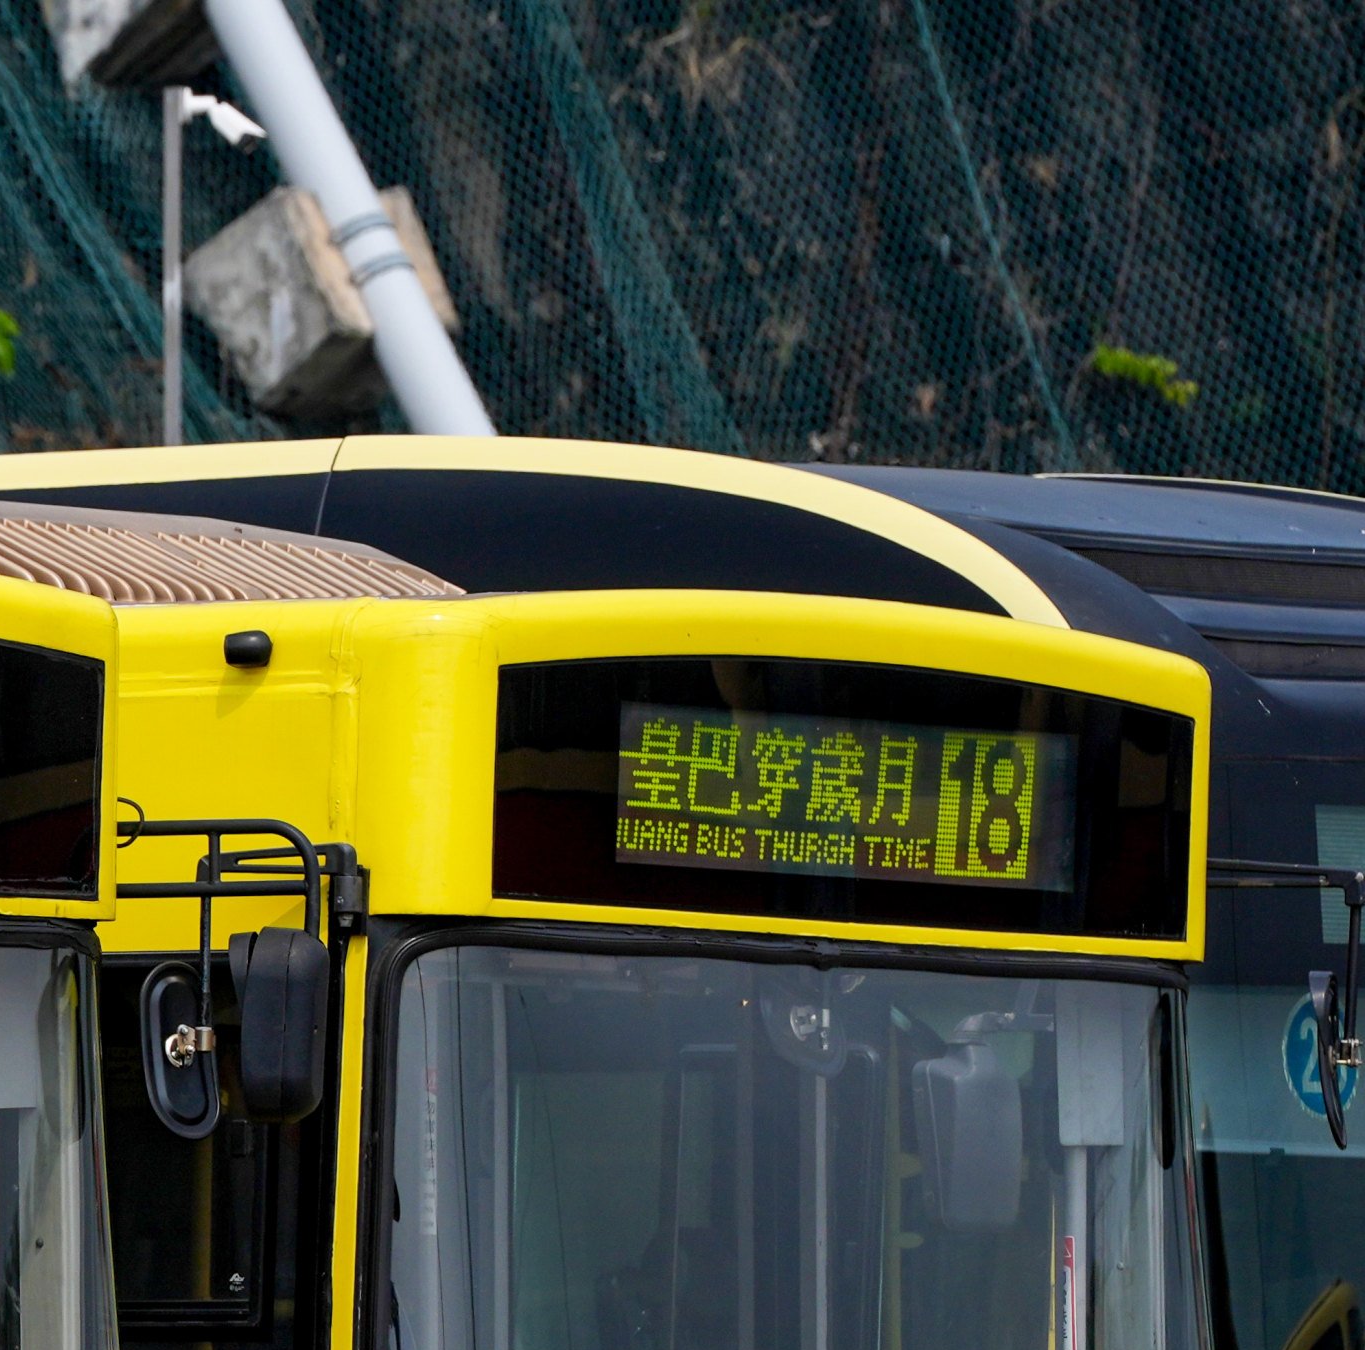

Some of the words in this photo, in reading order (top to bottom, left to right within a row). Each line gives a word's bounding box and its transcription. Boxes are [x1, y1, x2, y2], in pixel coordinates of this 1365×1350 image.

[619, 717, 918, 828] 皇巴穿歲月
[942, 735, 1030, 875] 18
[696, 824, 746, 859] BUS
[755, 829, 856, 866] THURGH
[863, 836, 932, 870] TIME
